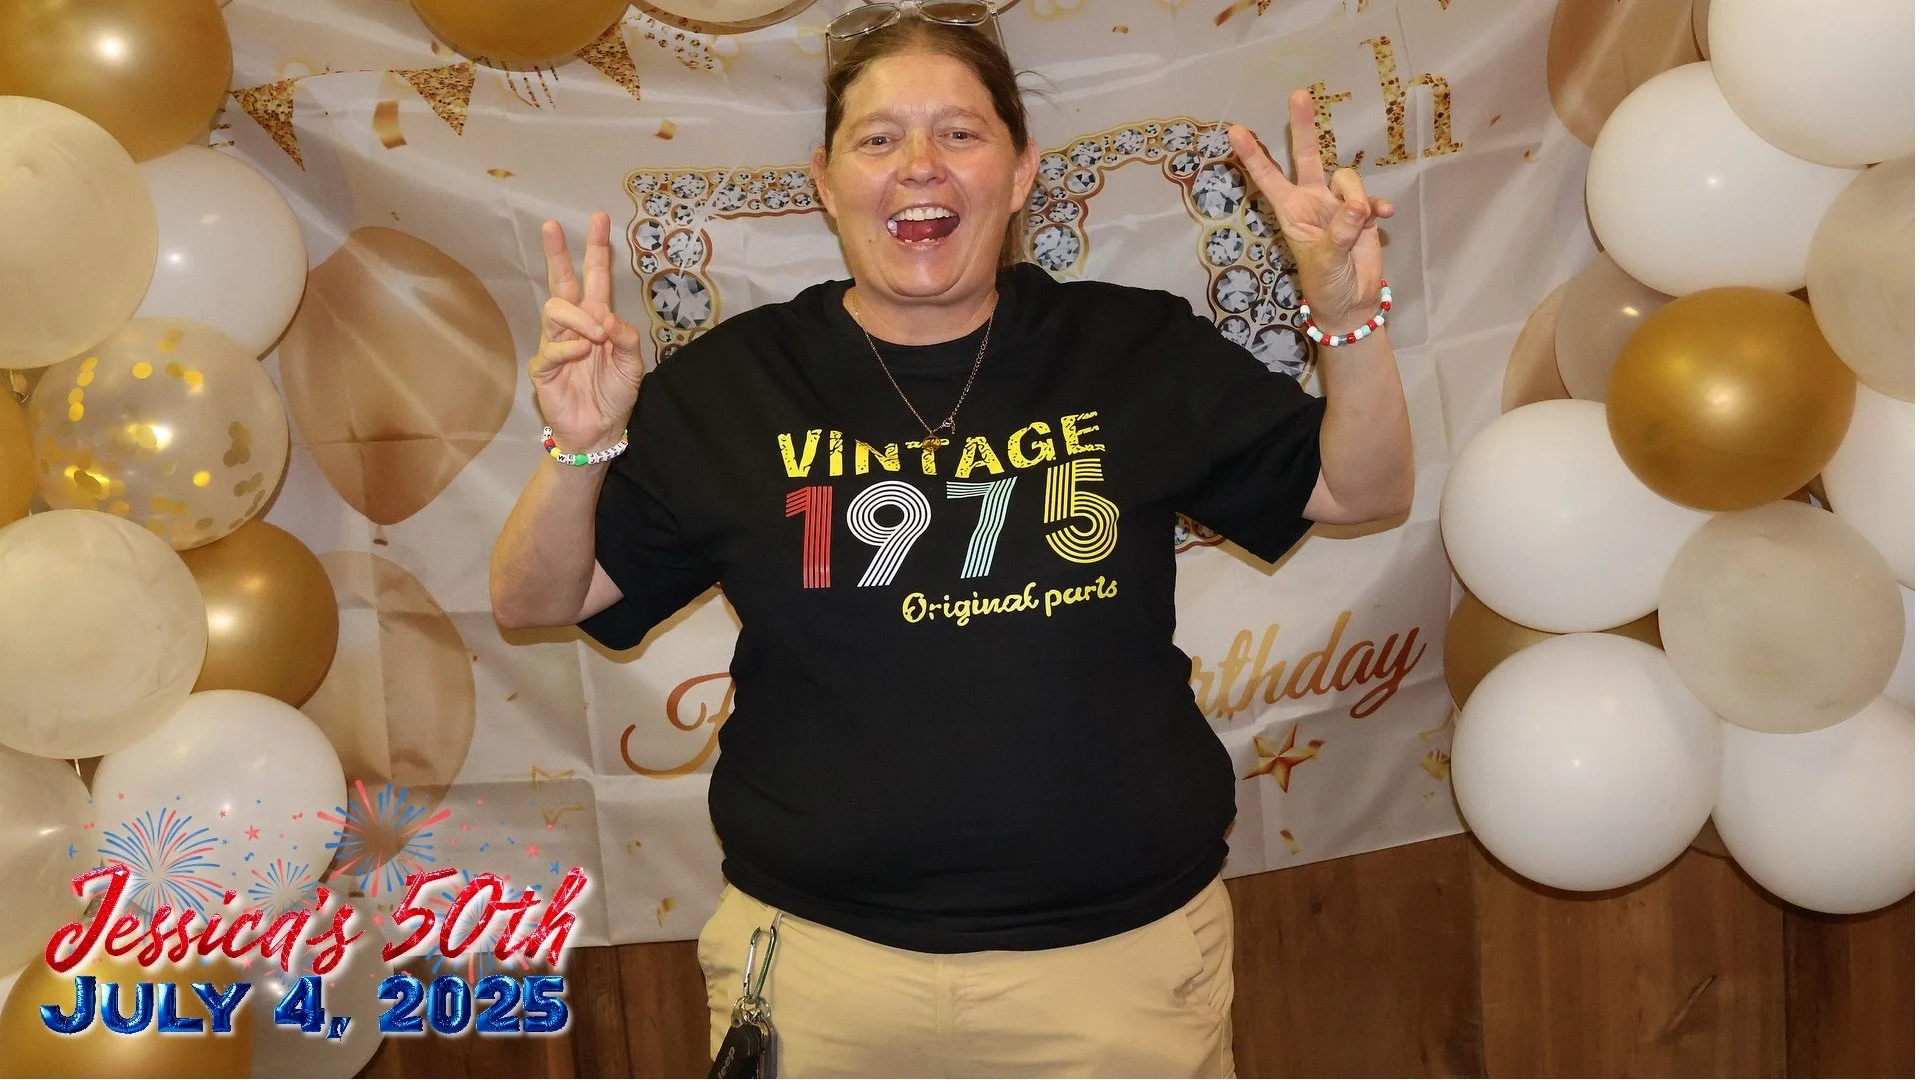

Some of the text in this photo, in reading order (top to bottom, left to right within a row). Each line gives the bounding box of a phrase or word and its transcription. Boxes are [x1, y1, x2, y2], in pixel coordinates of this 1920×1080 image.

[777, 410, 1106, 479] VINTAGE
[785, 458, 1121, 588] 1975
[902, 575, 1118, 627] Original parts
